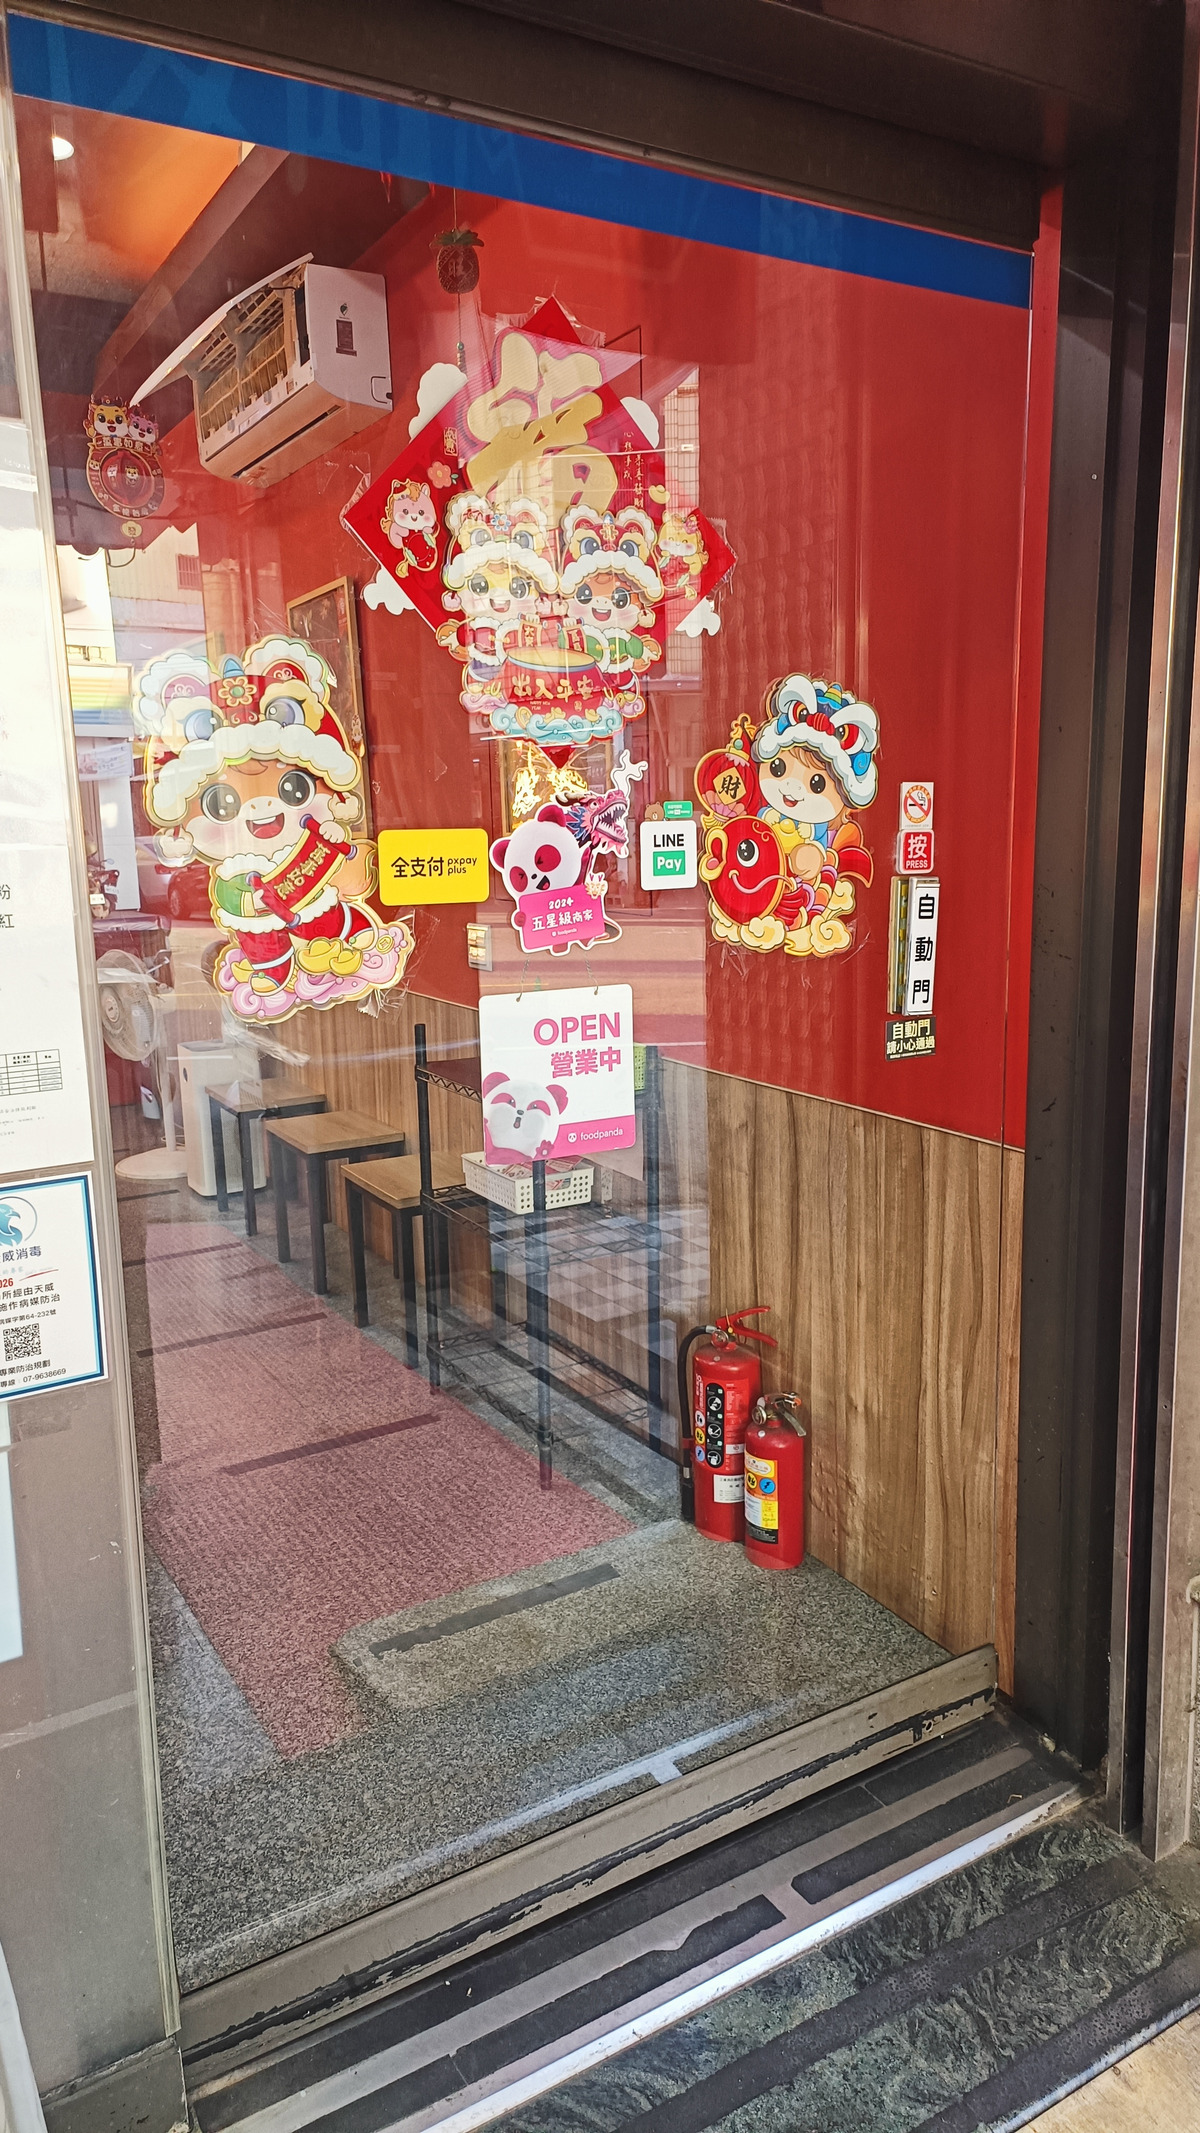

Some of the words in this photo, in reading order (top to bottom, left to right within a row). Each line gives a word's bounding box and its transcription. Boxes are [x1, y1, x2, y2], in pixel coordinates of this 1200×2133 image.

[511, 674, 594, 702] 出入平安
[718, 775, 742, 800] 財
[653, 833, 684, 848] LINE
[907, 834, 928, 859] 按
[391, 857, 444, 878] 全支付
[447, 857, 478, 867] pxpay
[447, 866, 467, 876] plus
[657, 856, 682, 872] Pay
[906, 859, 928, 869] PRESS
[548, 897, 574, 910] 2024
[531, 909, 593, 932] 五星級商家
[912, 893, 935, 1005] 自動門
[533, 1011, 621, 1046] OPEN
[892, 1019, 931, 1040] 自動門
[886, 1036, 935, 1055] 請小心通過
[550, 1046, 621, 1079] 營業中
[580, 1127, 624, 1142] foodpanda
[0, 1246, 41, 1263] 威消毒
[0, 1283, 55, 1300] 所經由天威
[23, 1368, 67, 1383] 07-9638669
